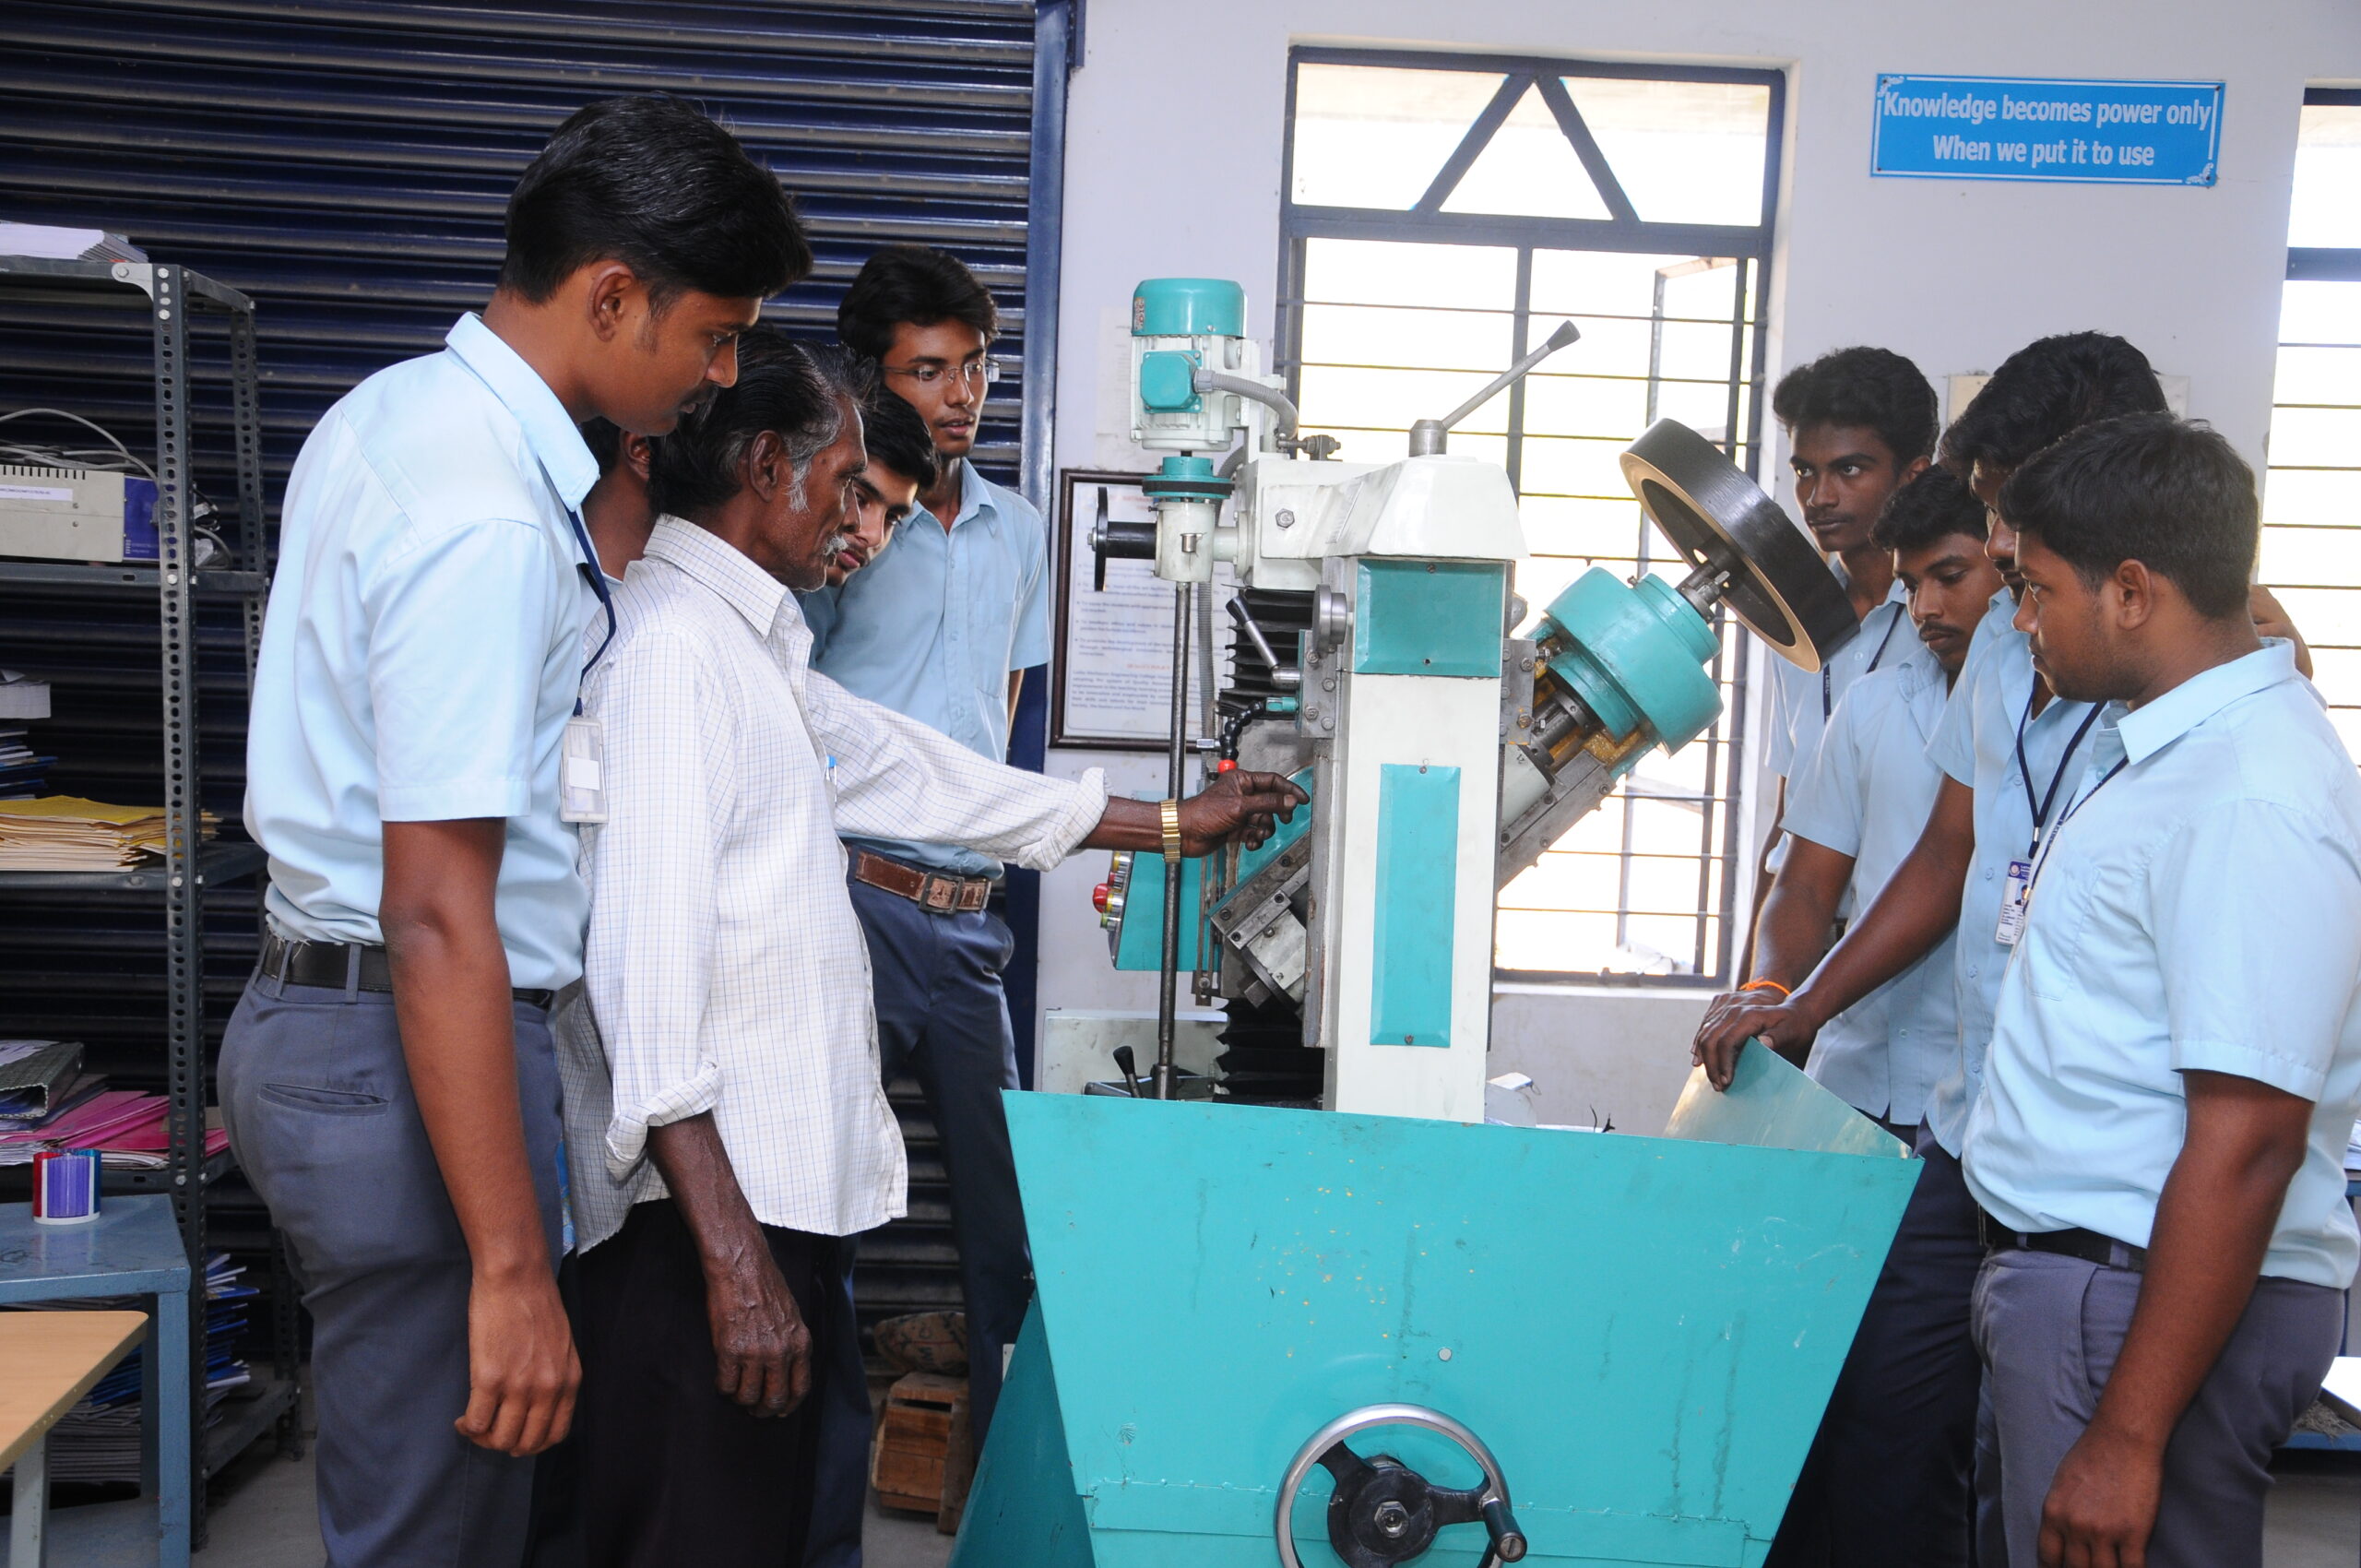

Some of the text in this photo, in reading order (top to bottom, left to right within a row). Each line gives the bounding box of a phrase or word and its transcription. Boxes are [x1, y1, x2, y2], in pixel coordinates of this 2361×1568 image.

[1883, 91, 2212, 131] Knowledge becomes power only
[1933, 135, 2154, 168] When we put it to use
